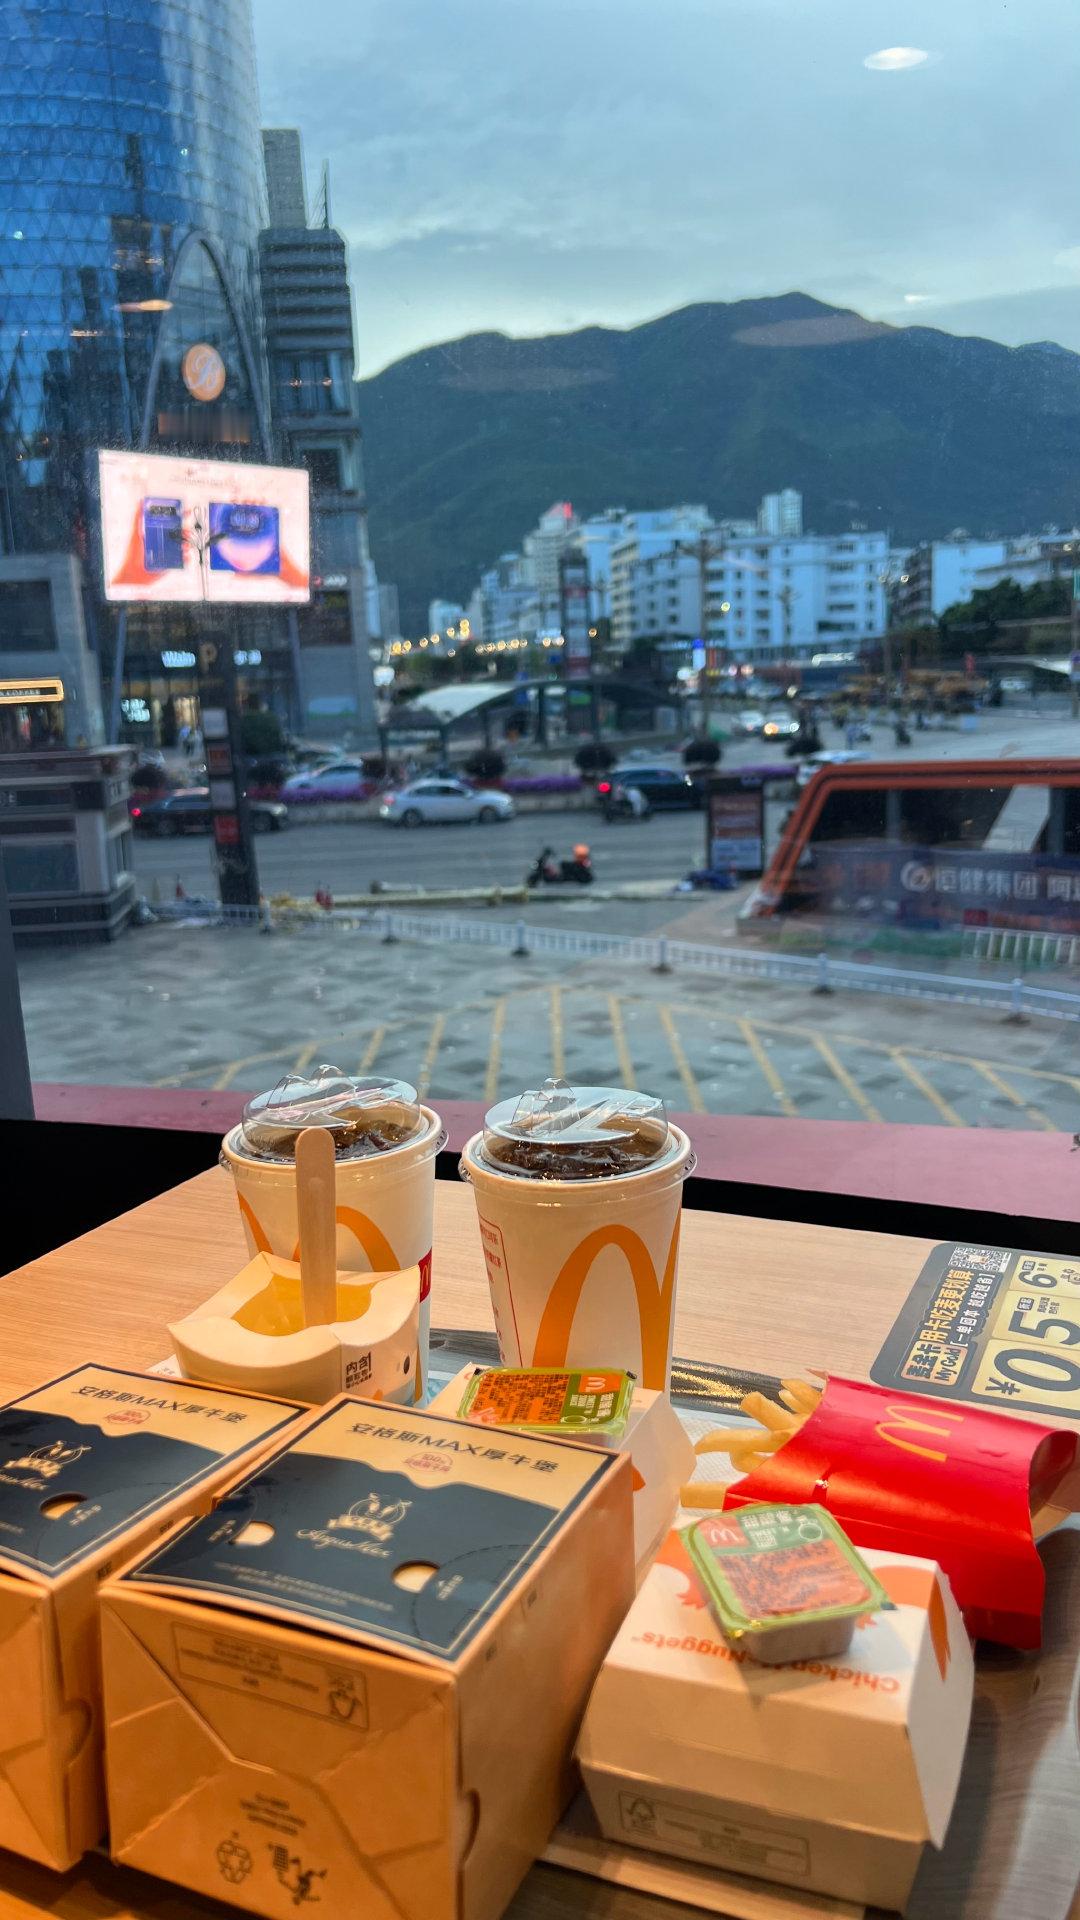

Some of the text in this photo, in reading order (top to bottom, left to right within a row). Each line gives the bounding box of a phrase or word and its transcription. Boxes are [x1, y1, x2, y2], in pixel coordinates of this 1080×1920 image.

[919, 1270, 974, 1343] 用卡吃麦更划算
[72, 1386, 247, 1423] 安格斯MAX厚牛堡
[347, 1423, 559, 1473] 安格斯MAX厚牛堡
